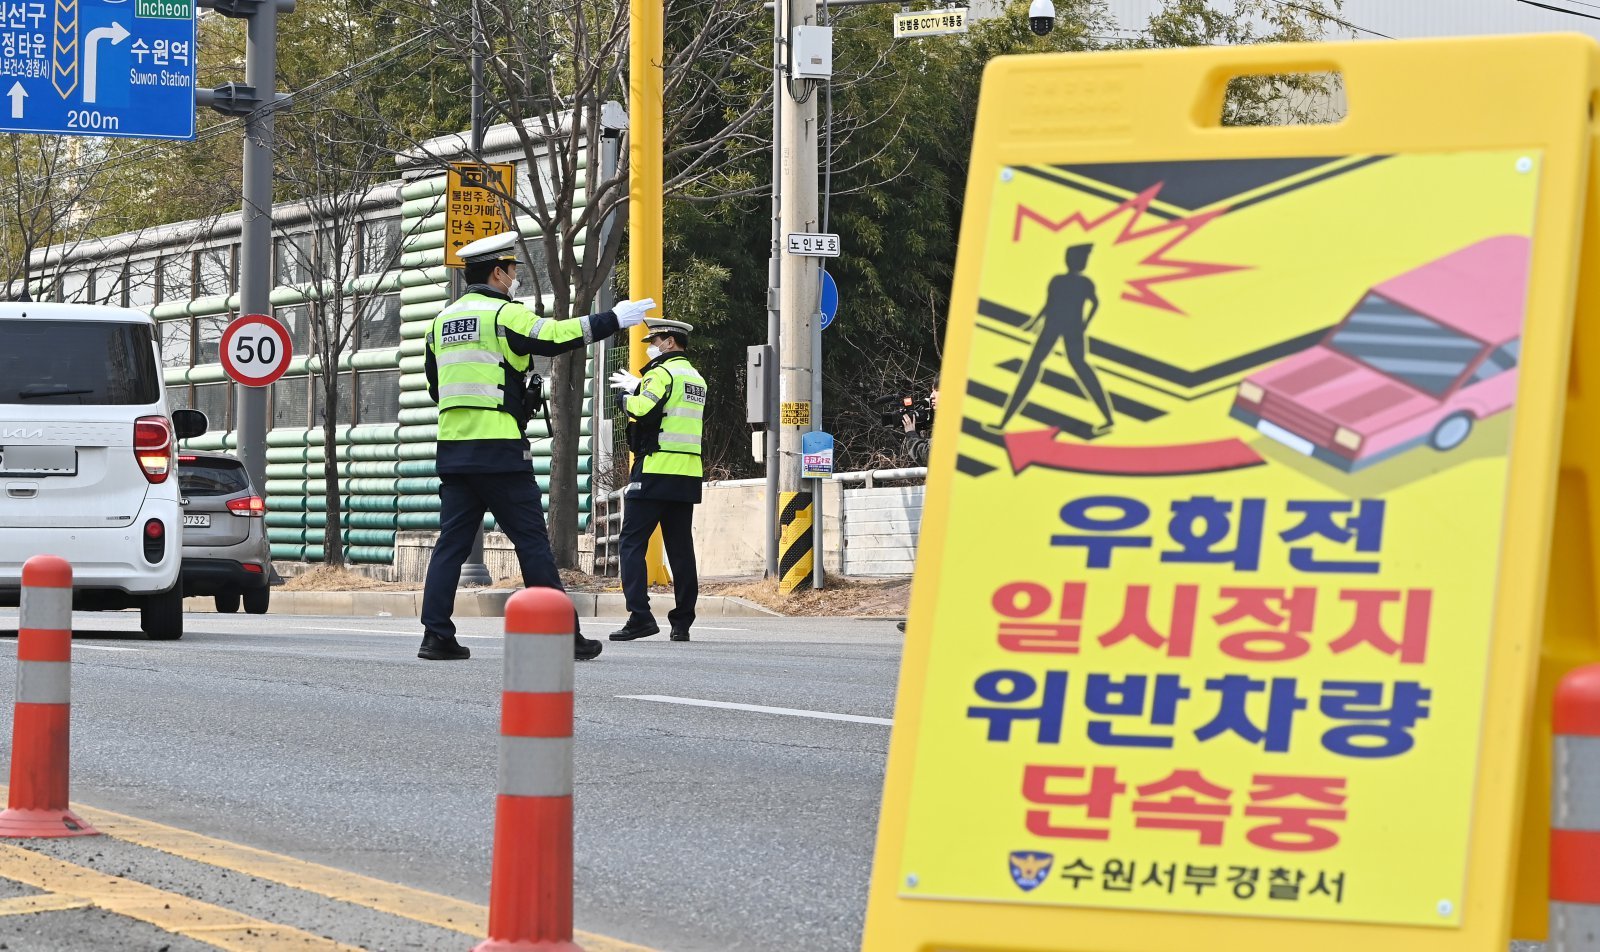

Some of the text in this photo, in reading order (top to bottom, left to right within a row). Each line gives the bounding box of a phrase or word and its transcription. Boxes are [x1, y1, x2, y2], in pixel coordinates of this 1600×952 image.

[138, 0, 189, 17] Incheon
[920, 18, 941, 29] CCTV
[942, 15, 962, 27] 작동중
[130, 38, 189, 67] 수원역
[130, 68, 190, 87] Suwon Station
[67, 110, 119, 130] 200m
[452, 190, 507, 204] 불법주.정
[451, 219, 475, 235] 단속
[790, 238, 837, 251] 노인보호
[443, 319, 475, 334] 교통경찰
[443, 333, 473, 343] POLICE
[235, 336, 276, 364] 50
[686, 395, 704, 404] POLICE
[1050, 495, 1386, 574] 우회전
[991, 581, 1433, 665] 일시정지
[966, 669, 1432, 759] 위반차량
[1021, 764, 1348, 853] 단속중
[1060, 857, 1347, 904] 수원서부경찰서
